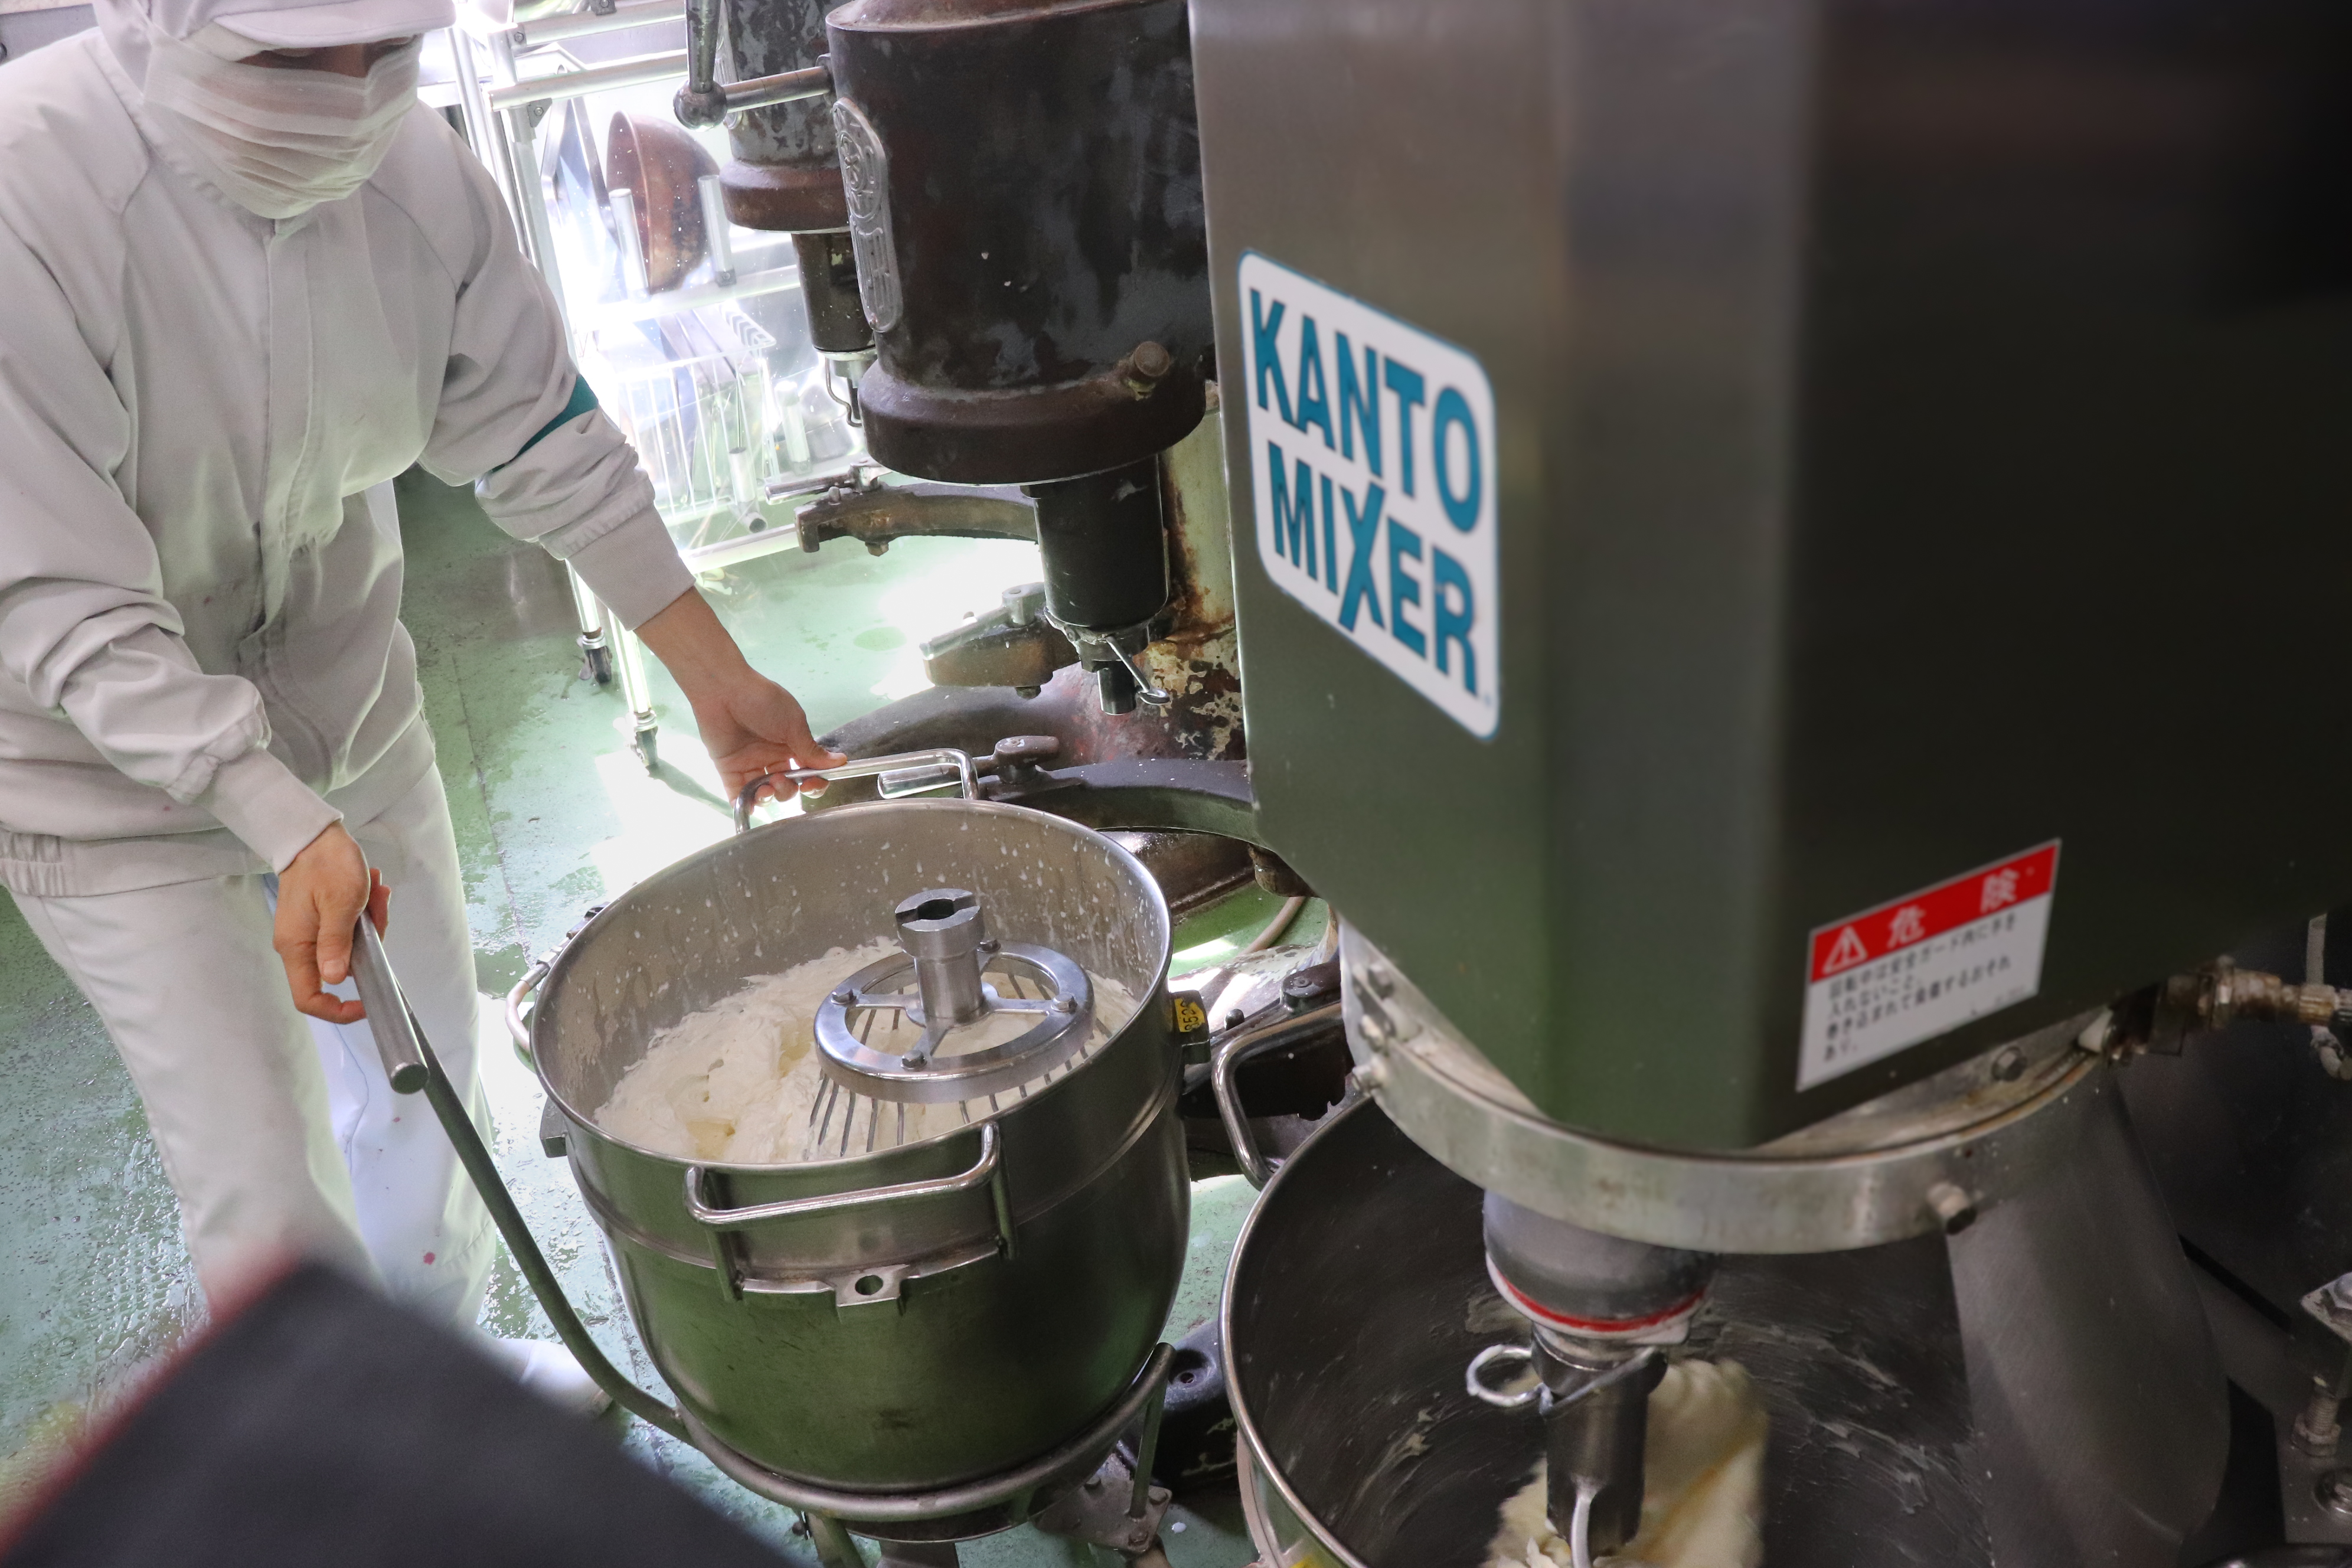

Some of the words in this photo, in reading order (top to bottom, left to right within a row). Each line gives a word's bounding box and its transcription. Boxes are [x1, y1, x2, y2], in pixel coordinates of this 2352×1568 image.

[1250, 287, 1482, 534] KANTO
[1268, 440, 1479, 698] MIXER
[1887, 868, 2020, 949] 危険
